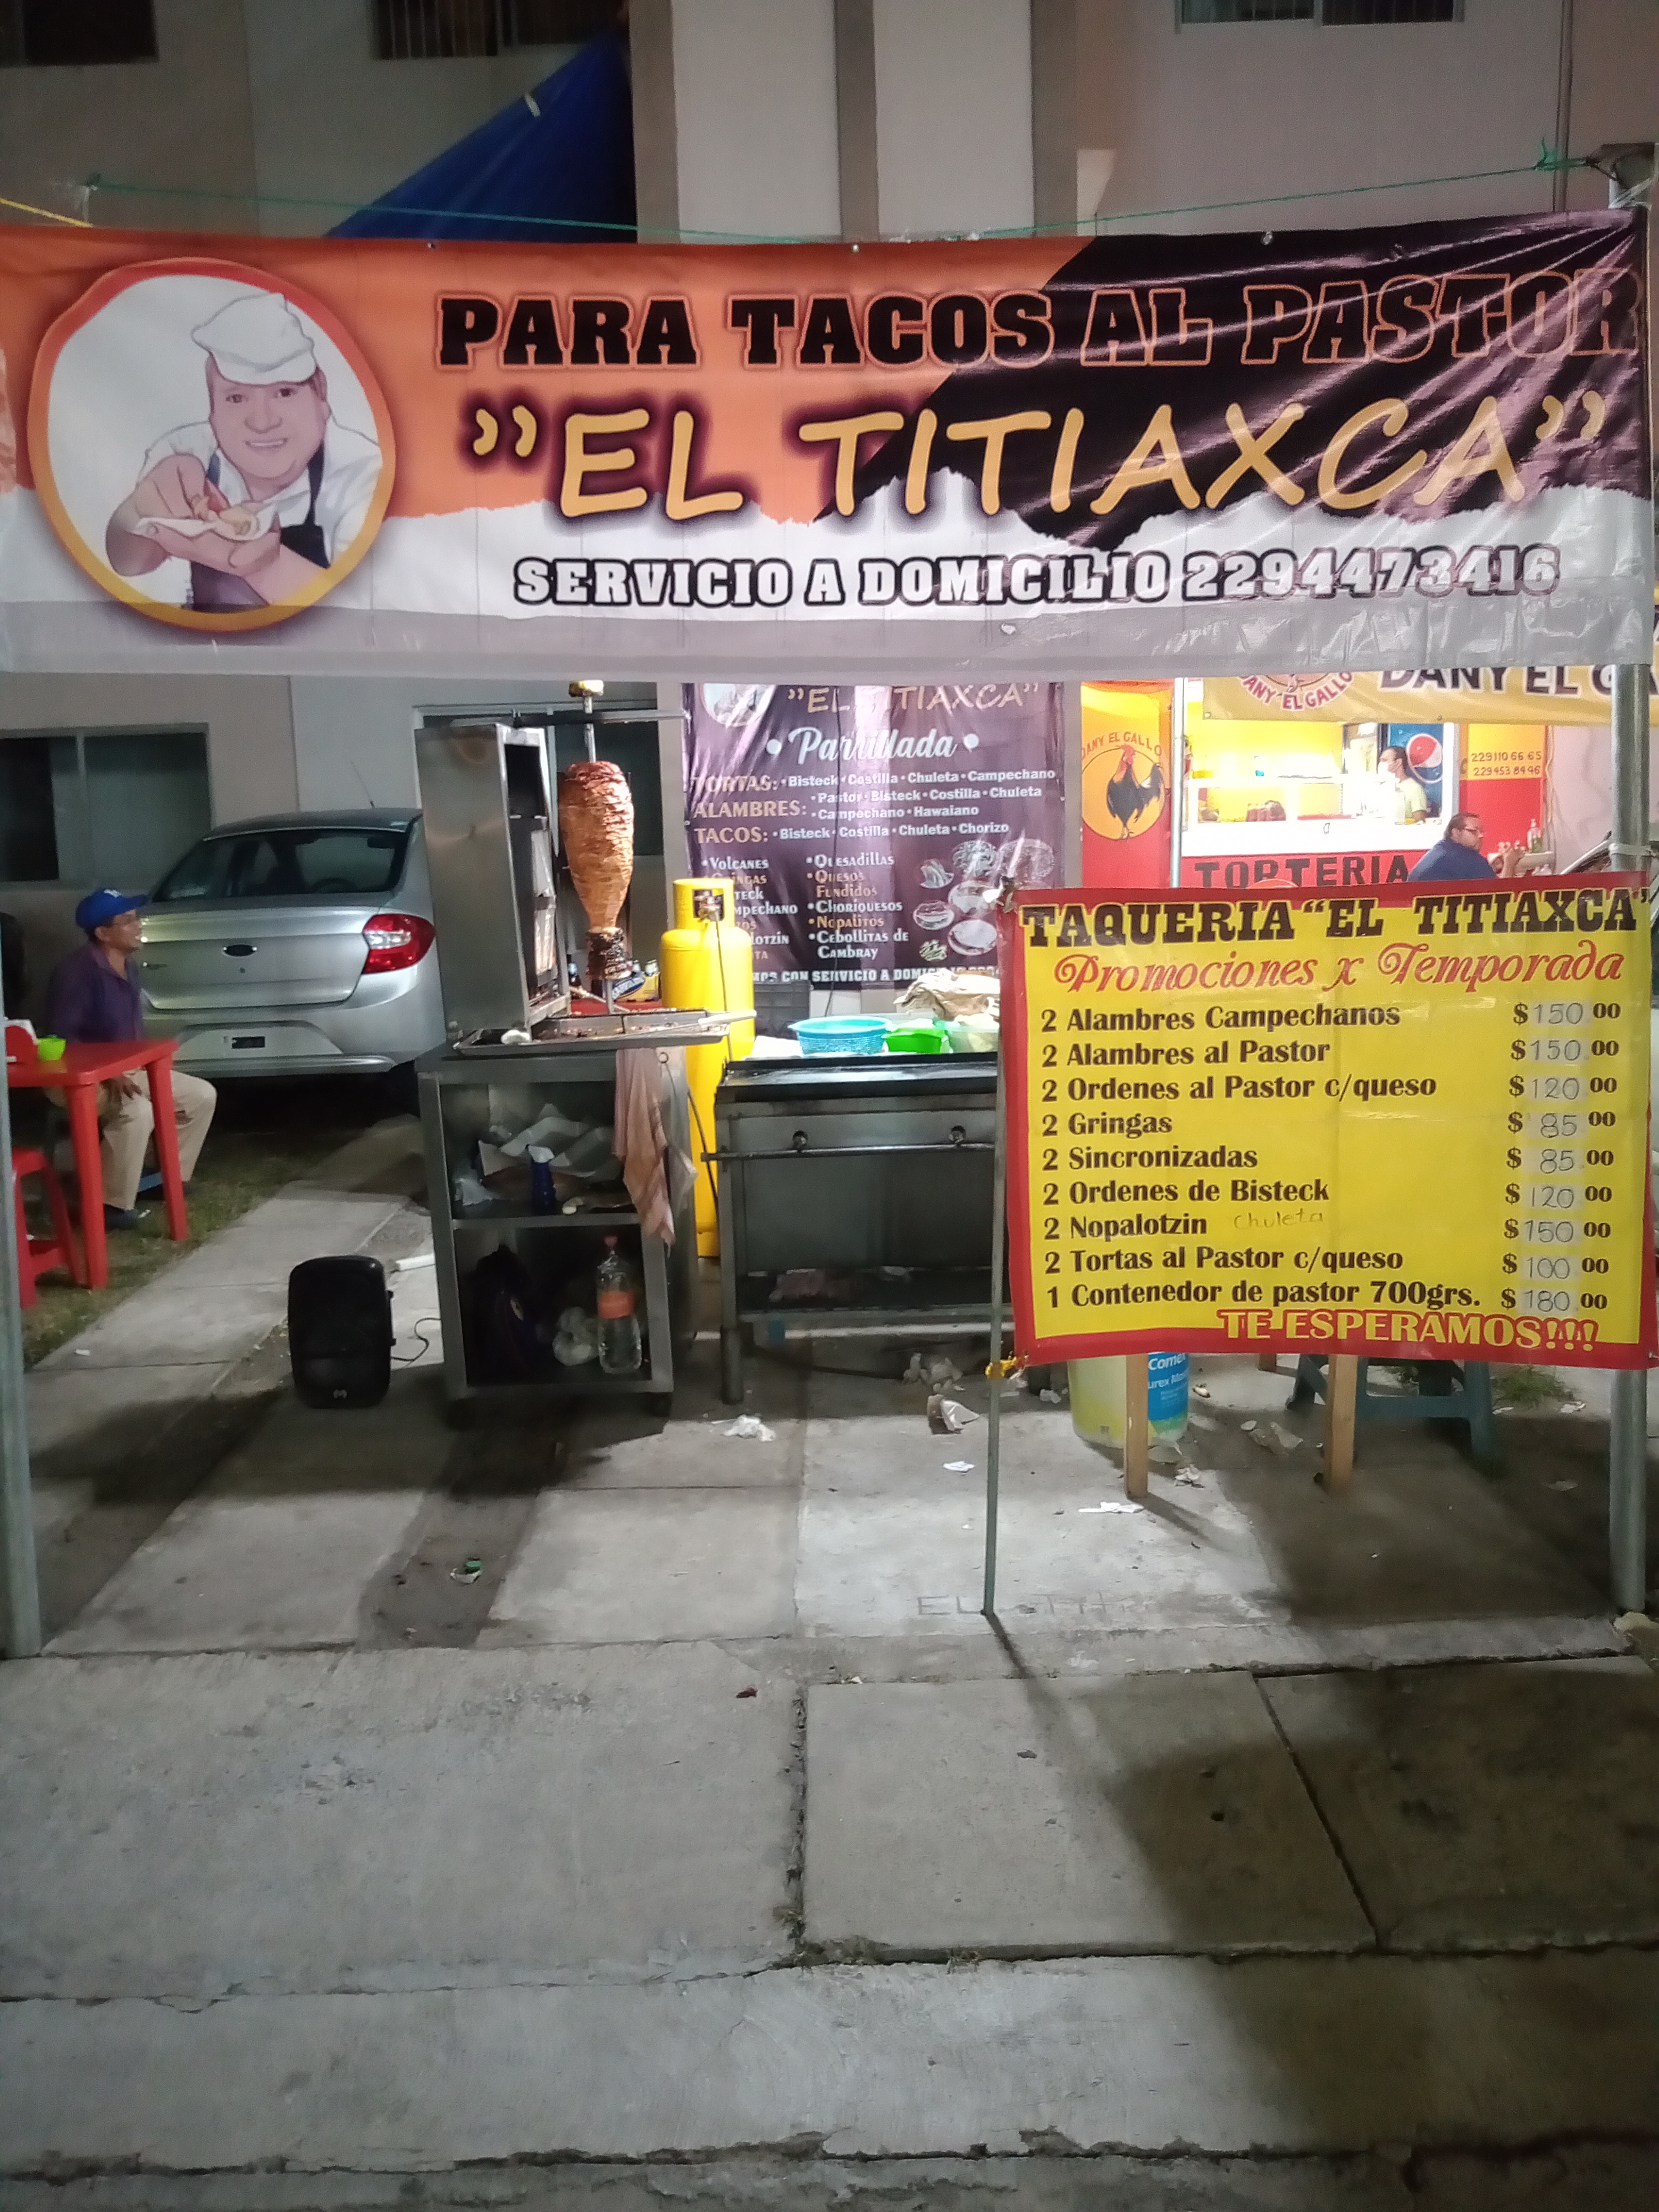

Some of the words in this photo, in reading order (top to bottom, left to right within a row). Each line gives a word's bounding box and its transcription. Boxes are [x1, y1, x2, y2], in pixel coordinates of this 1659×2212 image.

[438, 295, 700, 369] PARA
[726, 291, 1055, 369] TACOS
[1080, 288, 1213, 366] AL
[1242, 266, 1641, 366] PASTOR
[513, 557, 793, 606] SERVICIO
[804, 558, 845, 606] A
[858, 548, 1172, 606] DOMICILIO
[1182, 543, 1560, 603] 2294473416
[1239, 676, 1276, 703] ANY
[1283, 694, 1303, 709] EL
[1305, 673, 1352, 707] GALLO
[1381, 666, 1512, 691] DANY
[1527, 665, 1578, 694] EL
[1109, 732, 1120, 743] EL
[1123, 731, 1161, 757] GALLO
[788, 775, 838, 787] Bisteck
[848, 773, 898, 785] Costilla
[908, 772, 959, 784] Chuleta
[968, 769, 1055, 783] Campechano
[871, 790, 921, 802] Bisteck
[929, 788, 981, 800] Costilla
[990, 786, 1042, 799] Chuleta
[693, 800, 807, 818] ALAMBRES:
[818, 808, 904, 820] Campechano
[914, 805, 979, 817] Hawaiano
[694, 827, 768, 844] TACOS:
[780, 827, 831, 840] Bisteck
[839, 826, 890, 838] Costilla
[899, 824, 950, 836] Chuleta
[958, 822, 1010, 834] Chorizo
[1021, 900, 1295, 948] TAQUERIA
[811, 969, 877, 982] SERVICIO
[880, 969, 890, 981] A
[1054, 951, 1318, 993] Promociones
[1322, 957, 1363, 992] x
[1378, 939, 1625, 993] Temporada
[1041, 1010, 1057, 1033] 2
[1067, 1008, 1195, 1031] Alambres
[1205, 1003, 1400, 1032] Campechanos
[1042, 1044, 1058, 1068] 2
[1067, 1043, 1194, 1066] Alambres
[1204, 1041, 1228, 1063] al
[1239, 1040, 1330, 1063] Pastor
[1042, 1079, 1058, 1102] 2
[1068, 1077, 1180, 1100] Ordenes
[1189, 1076, 1213, 1099] al
[1225, 1075, 1316, 1099] Pastor
[1325, 1074, 1436, 1102] c/queso
[1042, 1114, 1058, 1136] 2
[1068, 1112, 1172, 1139] Gringas
[1043, 1148, 1058, 1171] 2
[1069, 1145, 1258, 1170] Sincronizadas
[1043, 1183, 1059, 1205] 2
[1069, 1179, 1178, 1204] Ordenes
[1189, 1179, 1220, 1202] de
[1231, 1178, 1329, 1202] Bisteck
[1044, 1218, 1060, 1240] 2
[1070, 1213, 1208, 1242] Nopalotzin
[1234, 1208, 1325, 1229] Chuleta
[1045, 1251, 1060, 1275] 2
[1070, 1249, 1153, 1273] Tortas
[1162, 1246, 1186, 1268] al
[1196, 1246, 1284, 1268] Pastor
[1294, 1246, 1404, 1273] c/queso
[1048, 1286, 1058, 1308] 1
[1072, 1280, 1222, 1307] Contenedor
[1231, 1280, 1262, 1303] de
[1272, 1283, 1360, 1307] pastor
[1370, 1280, 1481, 1310] 700grs.
[1218, 1310, 1271, 1339] TE
[1285, 1310, 1595, 1351] ESPERAMOS!!!
